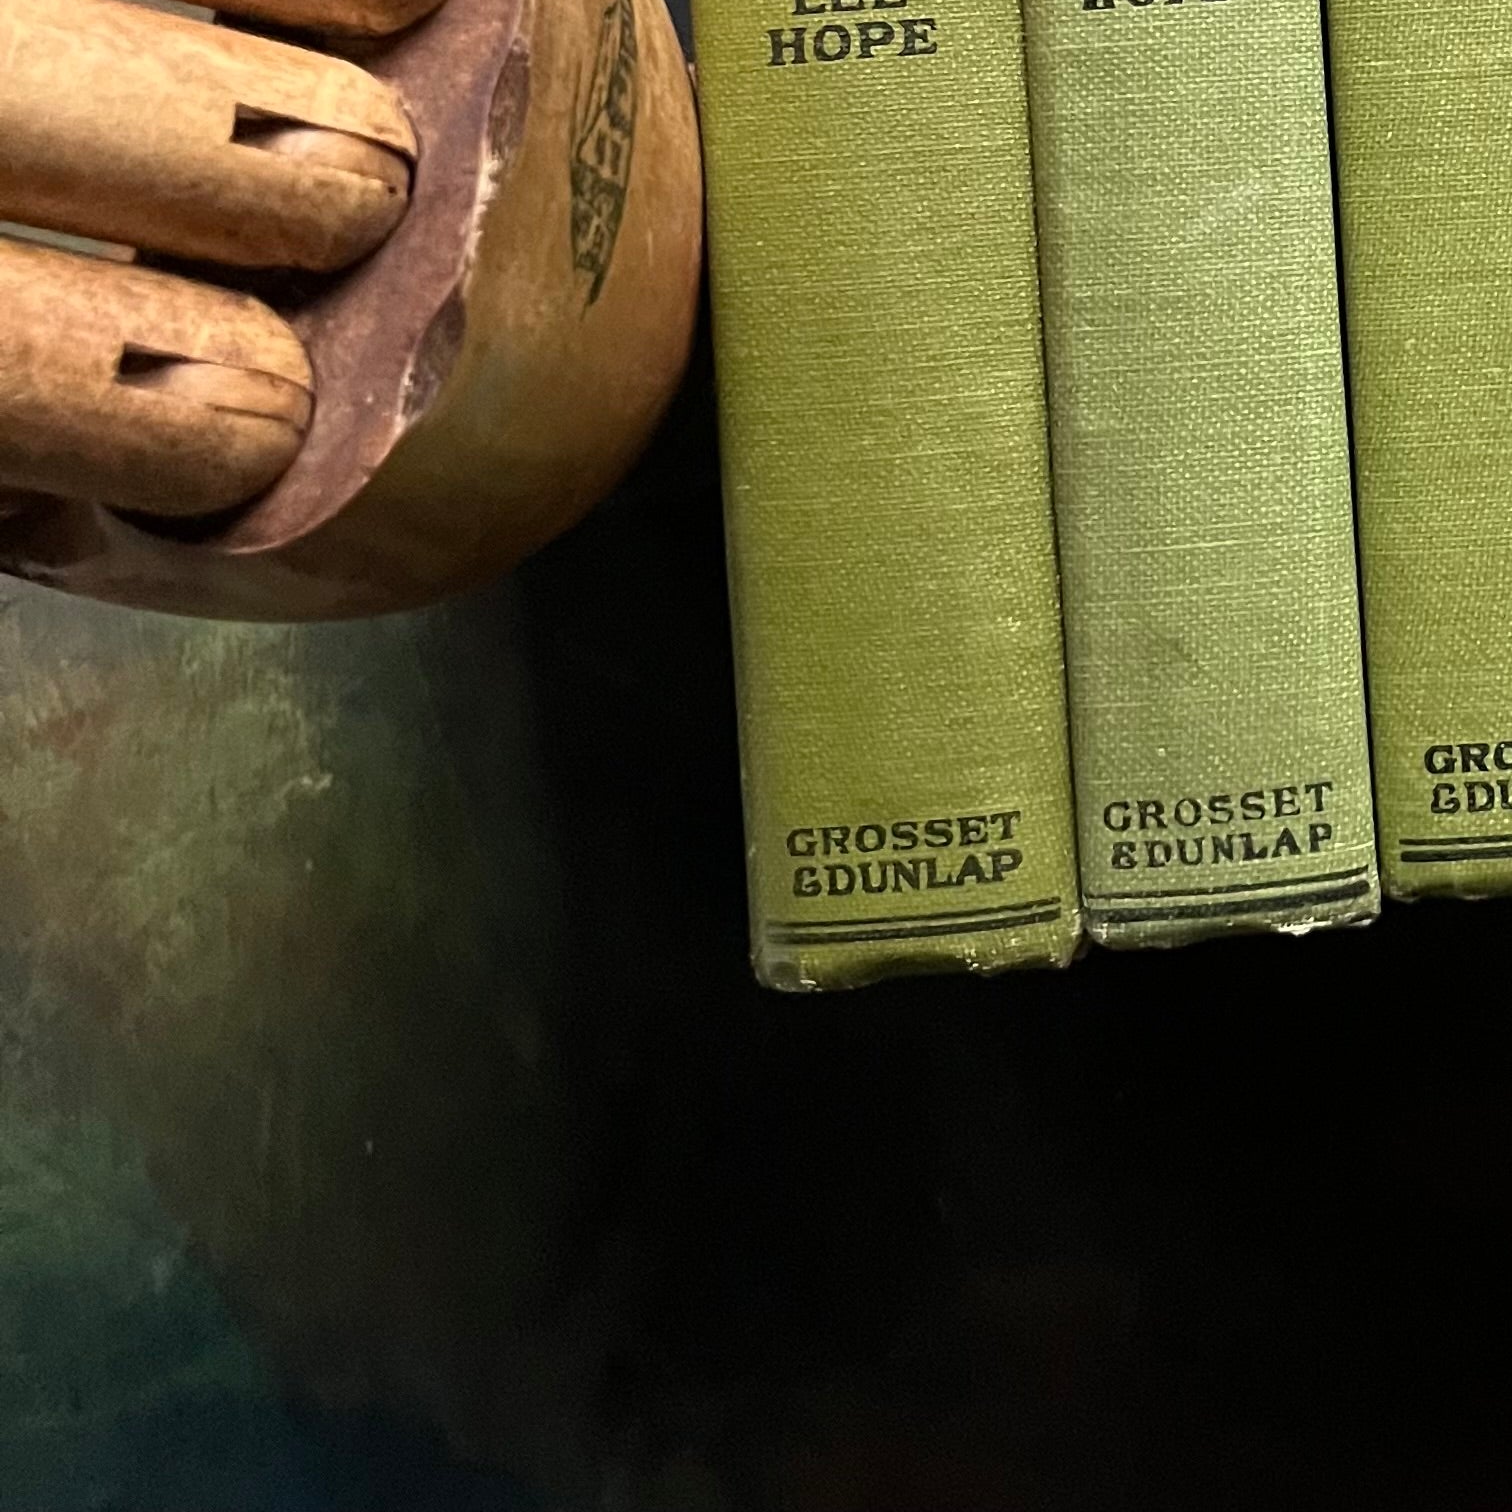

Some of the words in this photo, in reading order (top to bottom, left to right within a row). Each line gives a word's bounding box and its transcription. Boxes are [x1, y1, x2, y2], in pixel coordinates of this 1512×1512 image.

[766, 18, 939, 67] HOPE
[1103, 781, 1333, 834] GROSSET
[786, 810, 1022, 860] GROSSET
